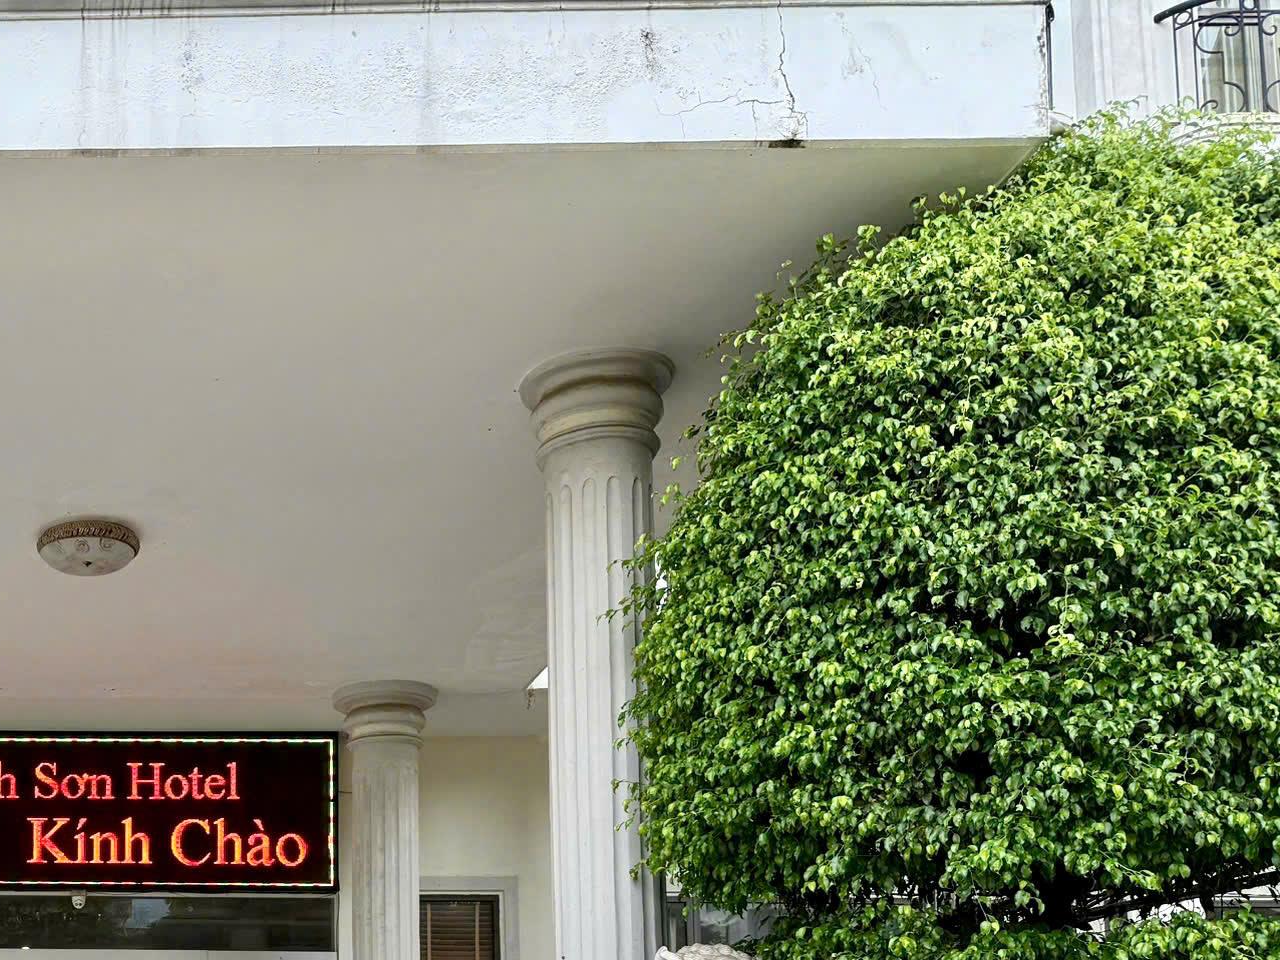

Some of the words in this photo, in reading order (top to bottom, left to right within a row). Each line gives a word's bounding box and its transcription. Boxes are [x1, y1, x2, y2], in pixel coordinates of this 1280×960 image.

[34, 761, 115, 800] Sơn
[126, 761, 240, 800] Hotel
[27, 817, 152, 864] Kính
[171, 817, 308, 867] Chào
